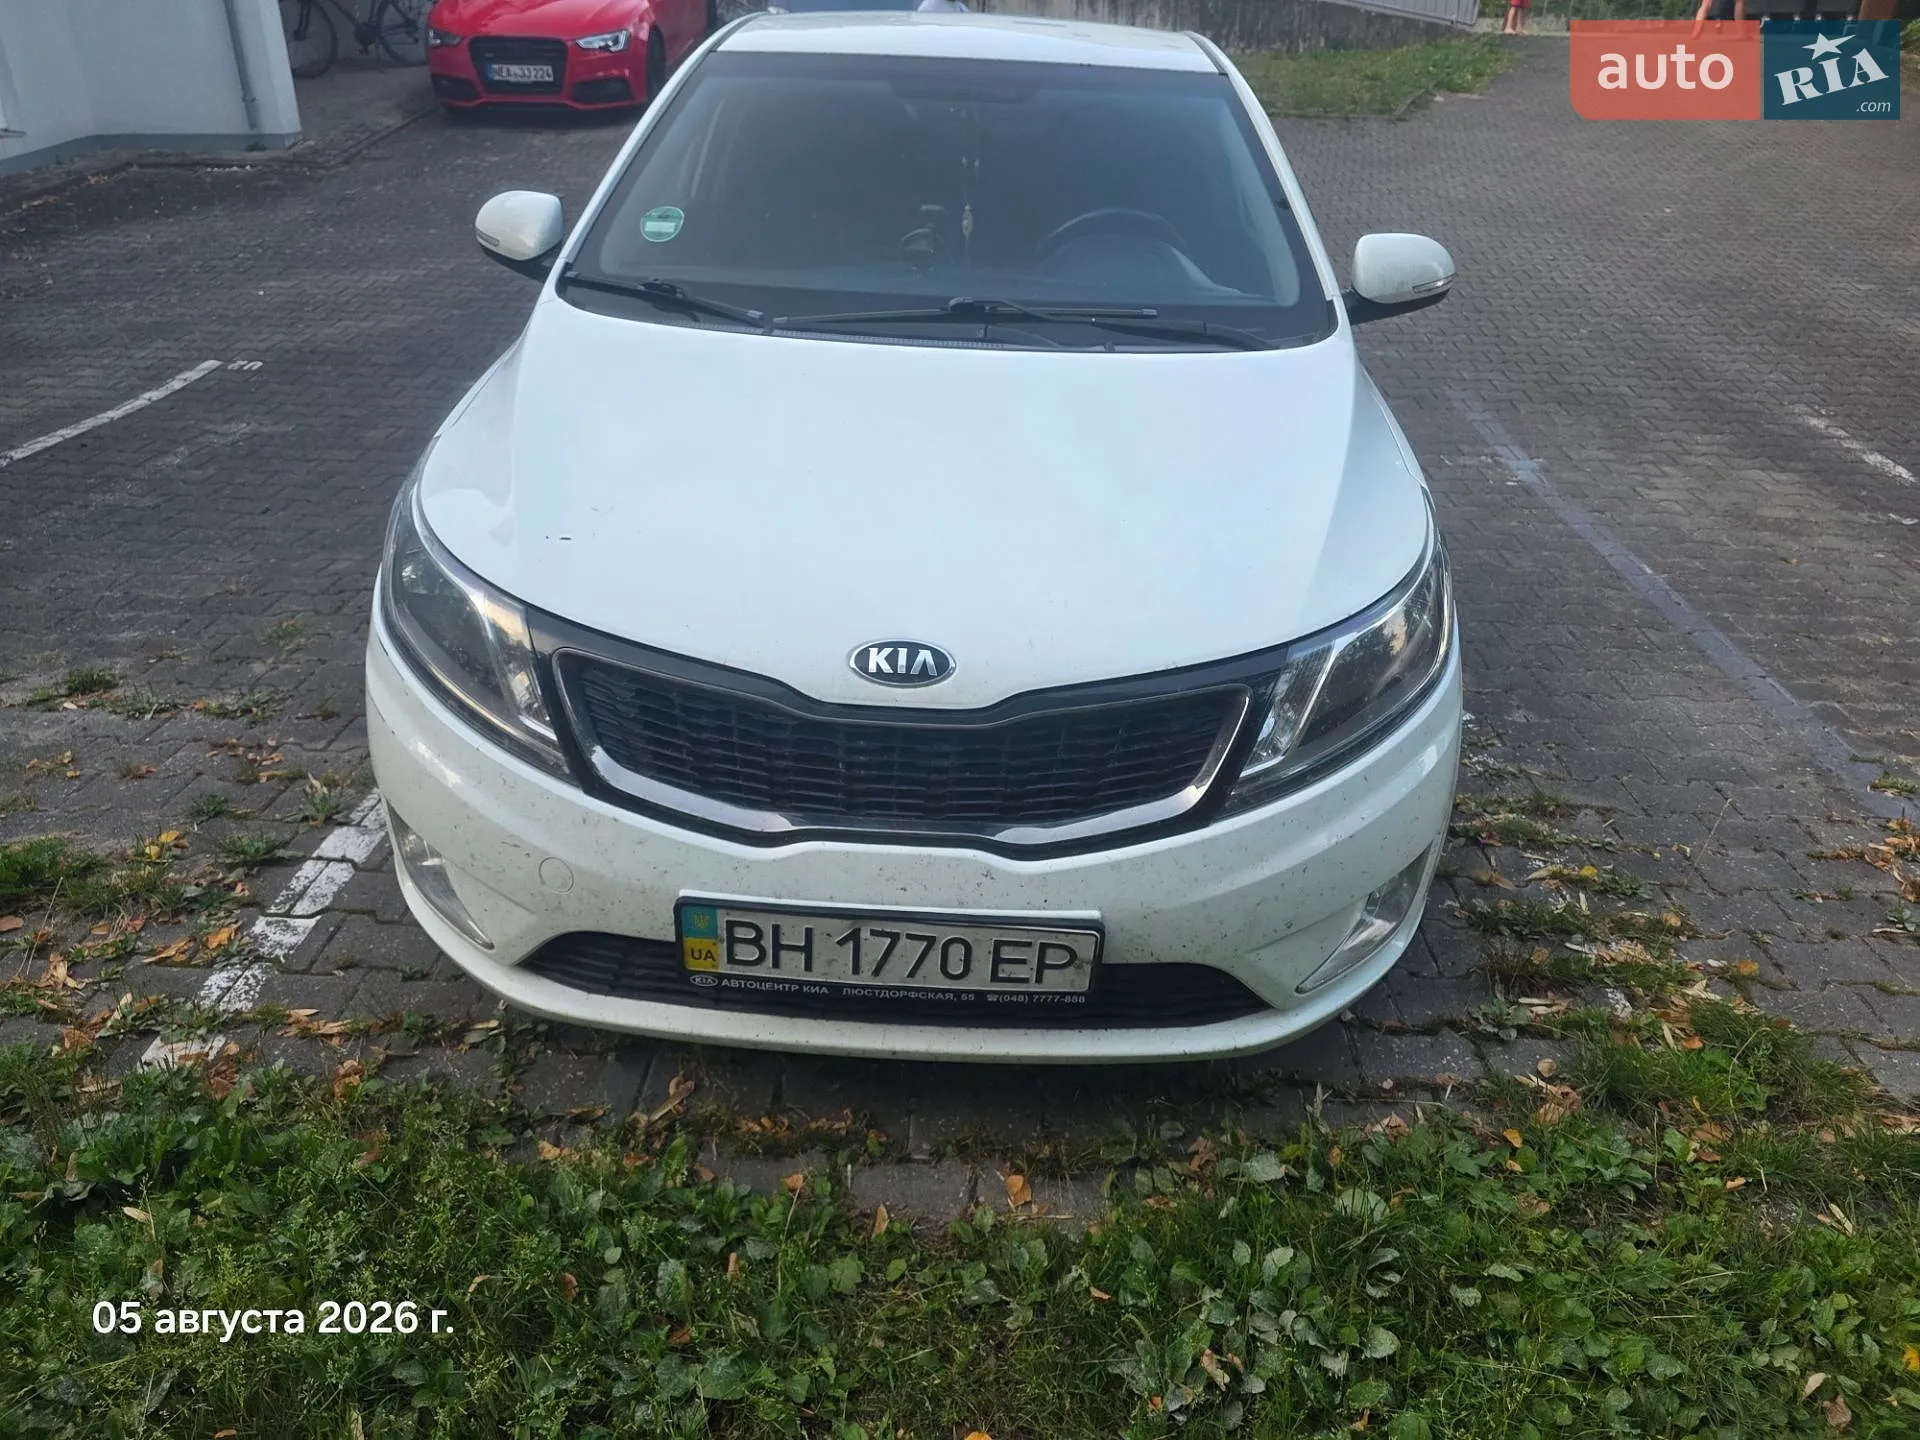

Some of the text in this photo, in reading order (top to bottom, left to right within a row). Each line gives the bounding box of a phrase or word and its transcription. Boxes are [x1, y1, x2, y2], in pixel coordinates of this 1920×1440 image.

[867, 647, 938, 676] KIA
[690, 948, 717, 962] UA
[725, 919, 1078, 984] BH 1770 EP
[720, 978, 800, 992] АВТОЦЕНТР
[802, 986, 830, 994] КИА
[842, 987, 957, 1001] ЛЮСТДОРФСКАЯ,
